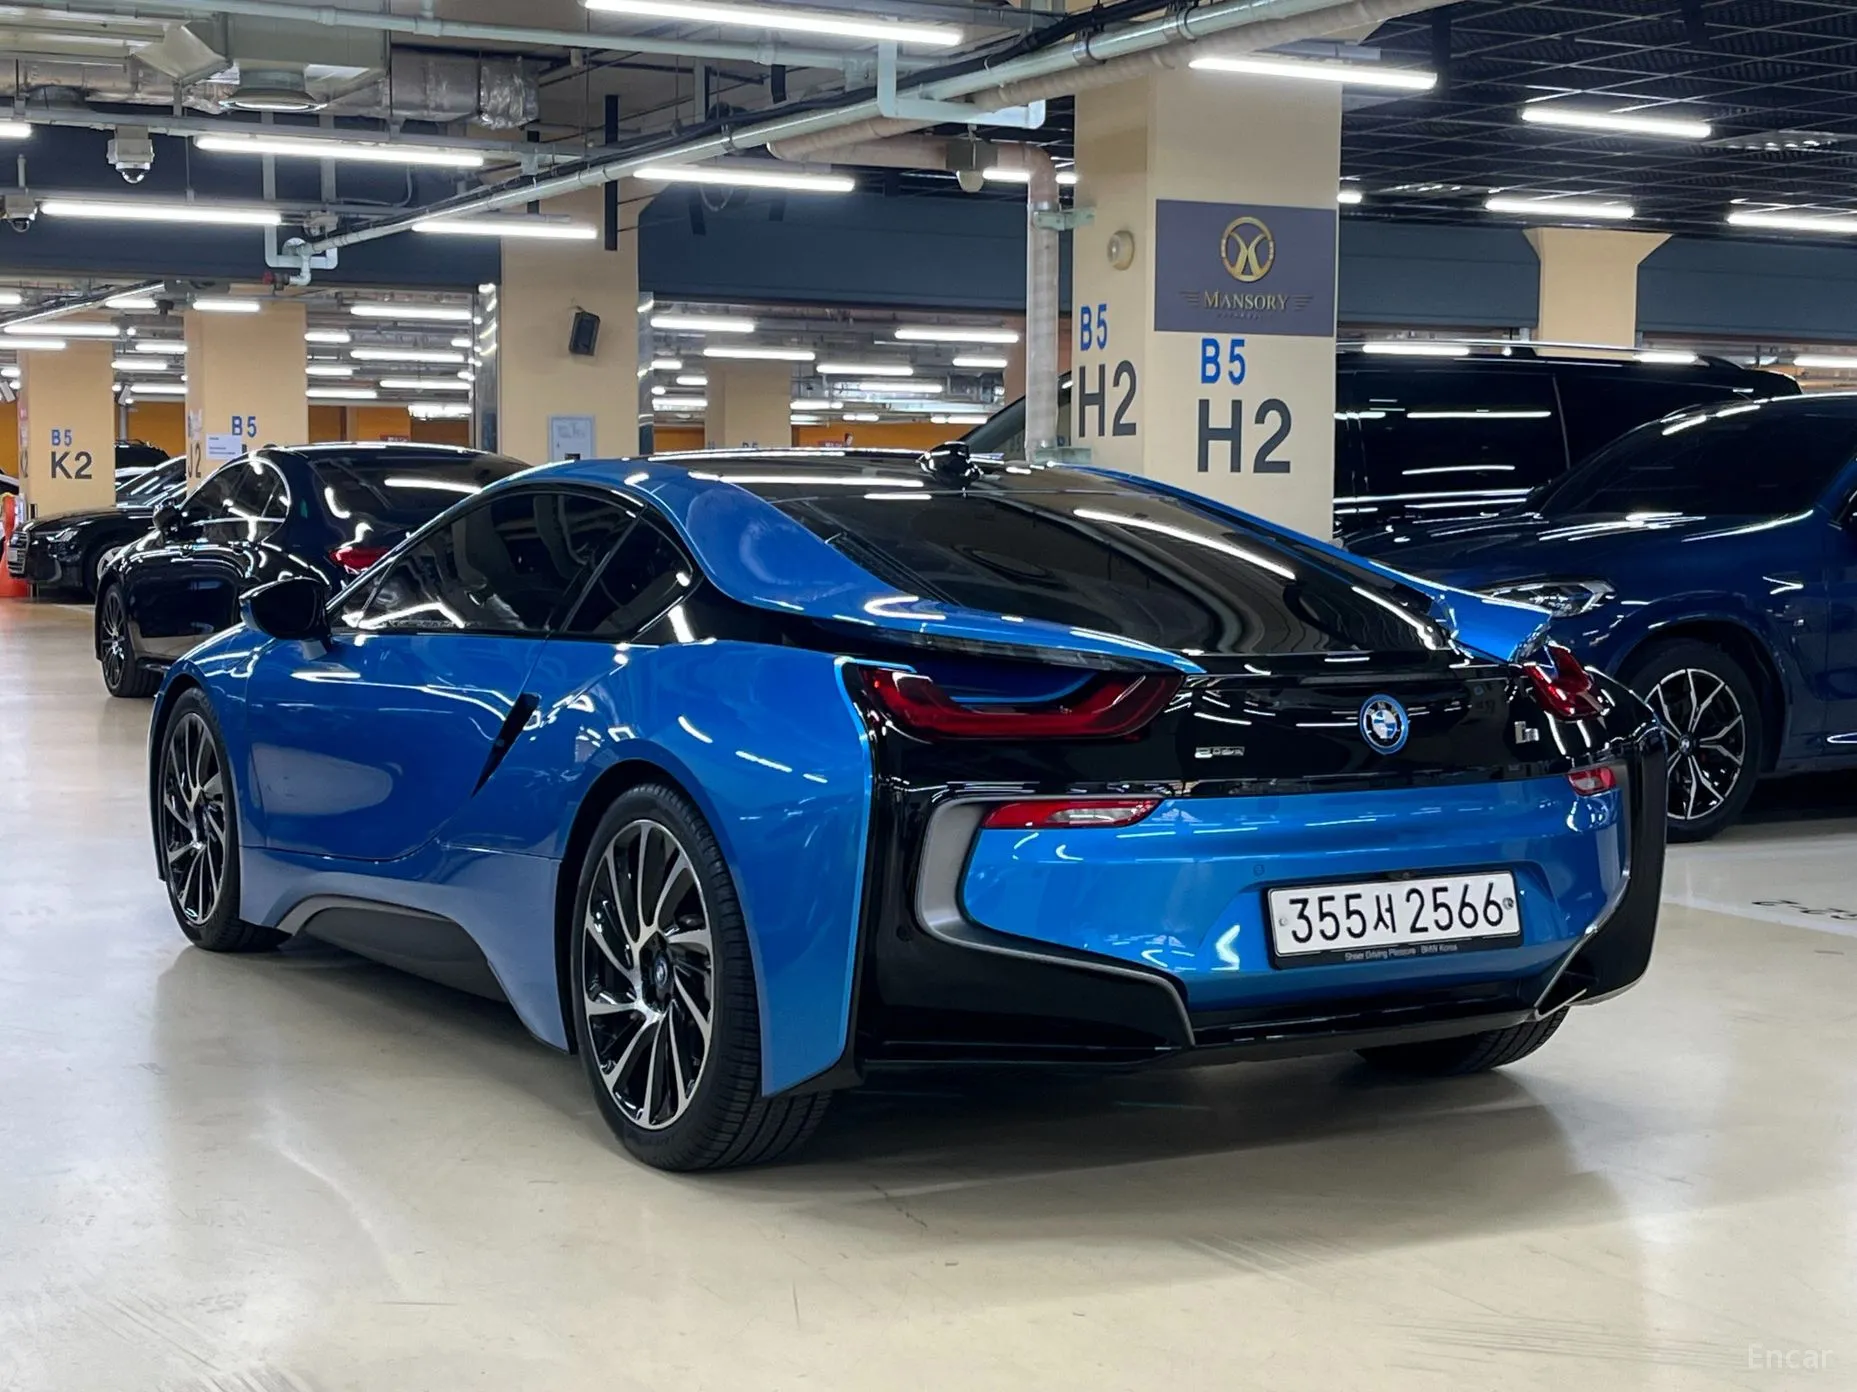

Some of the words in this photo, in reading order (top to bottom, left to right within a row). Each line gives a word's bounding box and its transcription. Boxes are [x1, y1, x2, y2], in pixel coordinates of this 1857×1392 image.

[1204, 288, 1289, 311] MANSORY
[1080, 303, 1107, 351] B5
[1201, 338, 1246, 385] B5
[1078, 360, 1137, 438] H2
[51, 429, 73, 447] B5
[232, 416, 257, 438] B5
[1197, 398, 1292, 474] H2
[51, 451, 93, 480] K2
